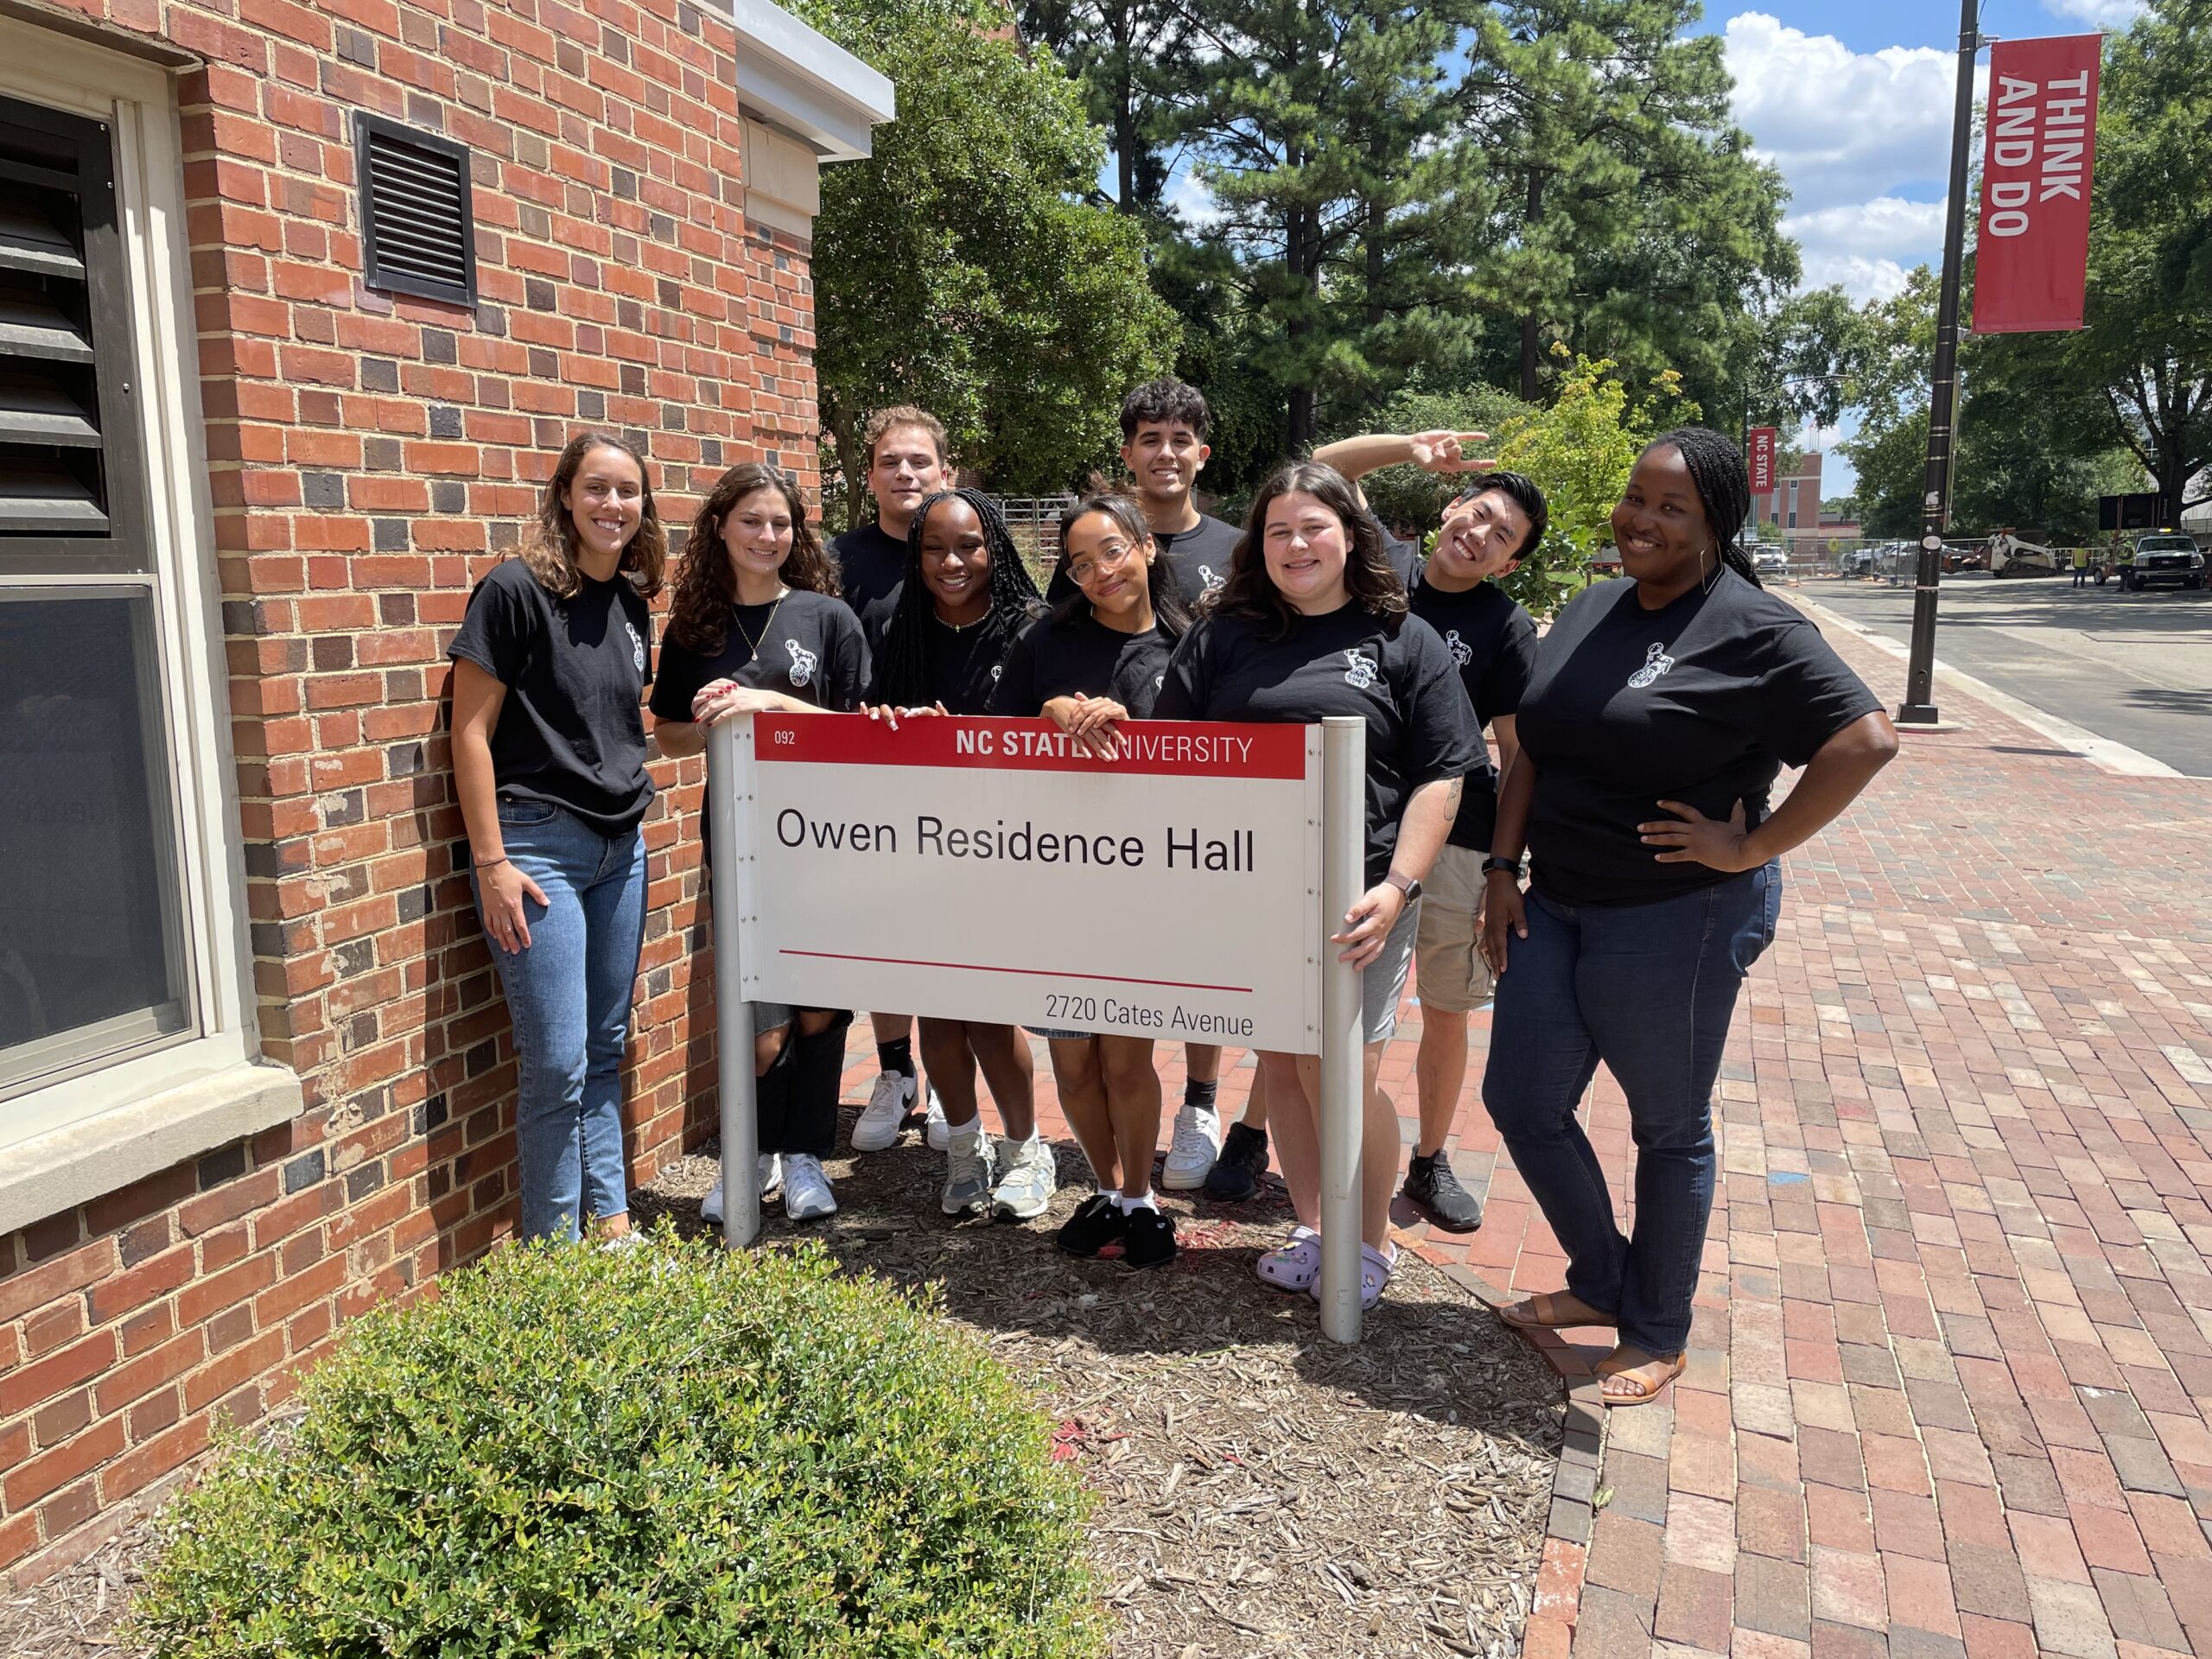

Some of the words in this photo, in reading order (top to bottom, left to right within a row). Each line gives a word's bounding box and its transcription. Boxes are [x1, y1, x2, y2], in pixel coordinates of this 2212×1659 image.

[1994, 76, 2038, 168] AND
[2039, 69, 2088, 202] THINK
[1988, 181, 2031, 238] DO
[1756, 435, 1769, 452] NC
[1756, 454, 1768, 487] STATE
[774, 730, 795, 745] 092
[957, 729, 994, 755] NC
[1107, 734, 1253, 763] NIVERSITY
[777, 808, 896, 853] Owen
[918, 816, 1144, 868] Residence
[1166, 827, 1253, 872] Hall
[1046, 994, 1096, 1023] 2720
[1103, 999, 1163, 1029] Cates
[1171, 1005, 1253, 1037] Avenue
